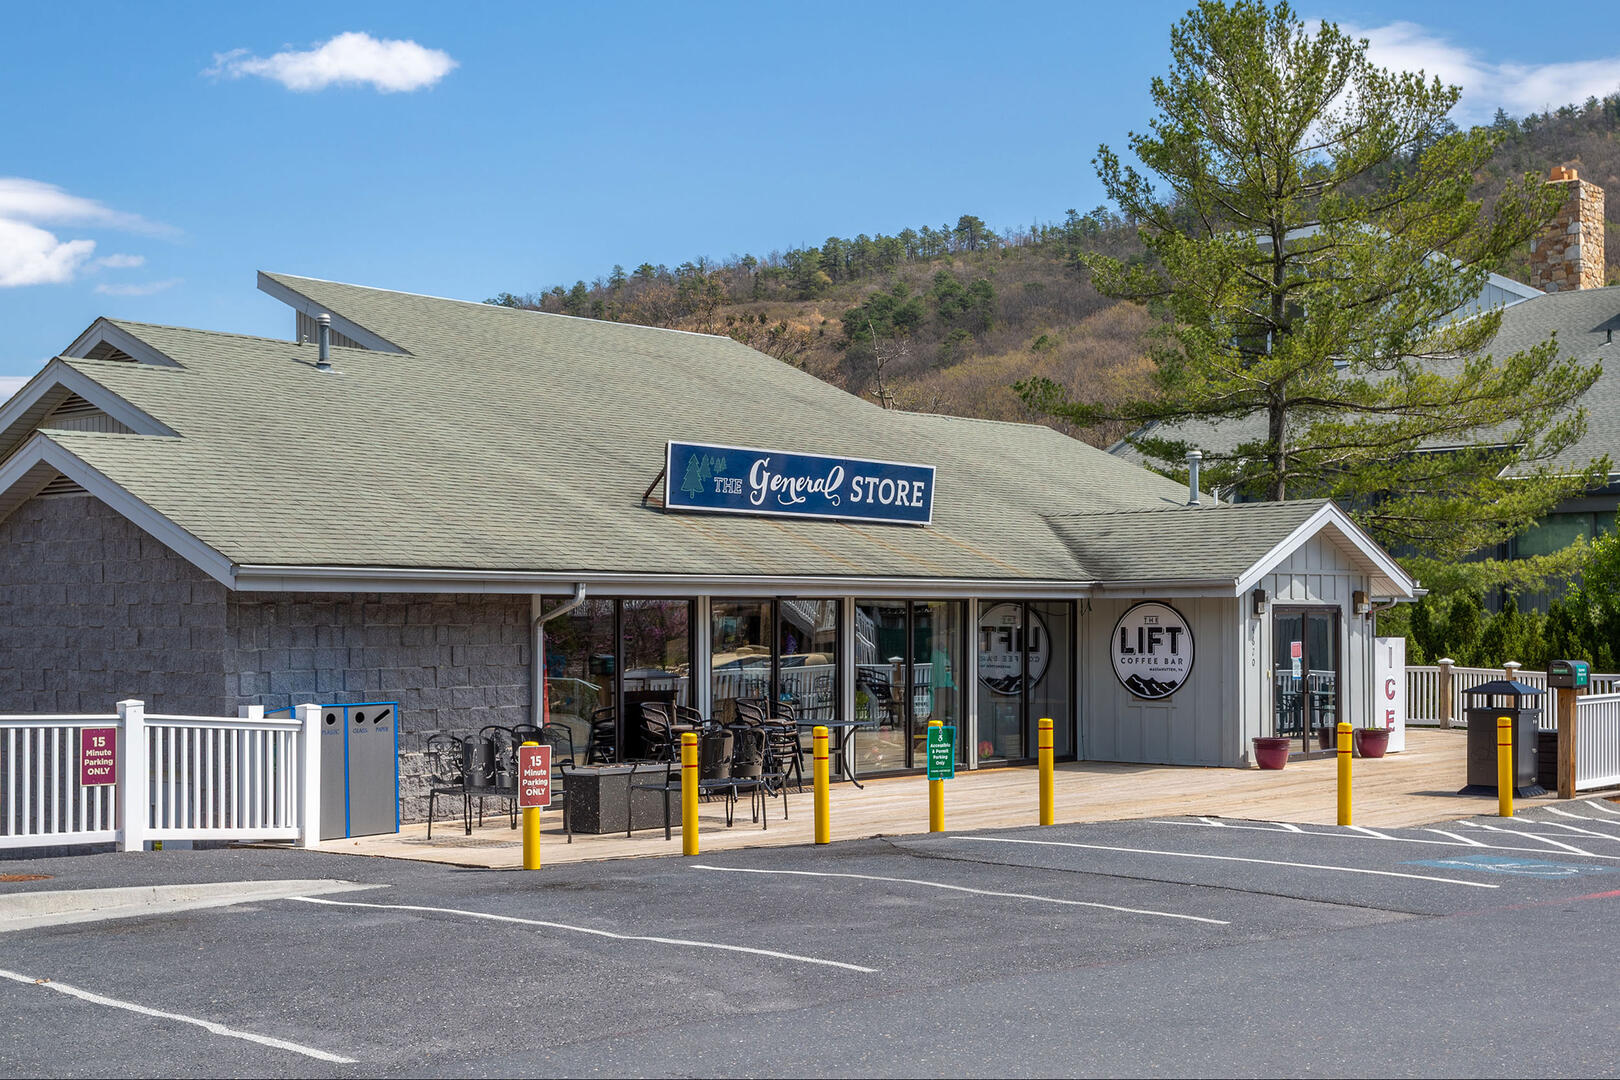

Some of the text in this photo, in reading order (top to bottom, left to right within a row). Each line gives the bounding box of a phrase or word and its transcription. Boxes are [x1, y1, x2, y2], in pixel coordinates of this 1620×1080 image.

[714, 477, 743, 494] THE
[850, 476, 925, 507] STORE
[1144, 616, 1159, 624] THE
[1120, 626, 1184, 656] LIFT
[1120, 657, 1183, 665] COFFEE BAR
[1384, 646, 1396, 732] ICE
[92, 736, 106, 747] 15
[86, 749, 112, 757] Minute
[84, 758, 114, 766] Parking
[530, 755, 542, 767] 15
[87, 767, 111, 775] ONLY
[523, 769, 547, 777] Minute
[522, 778, 548, 786] Parking
[525, 787, 546, 796] ONLY
